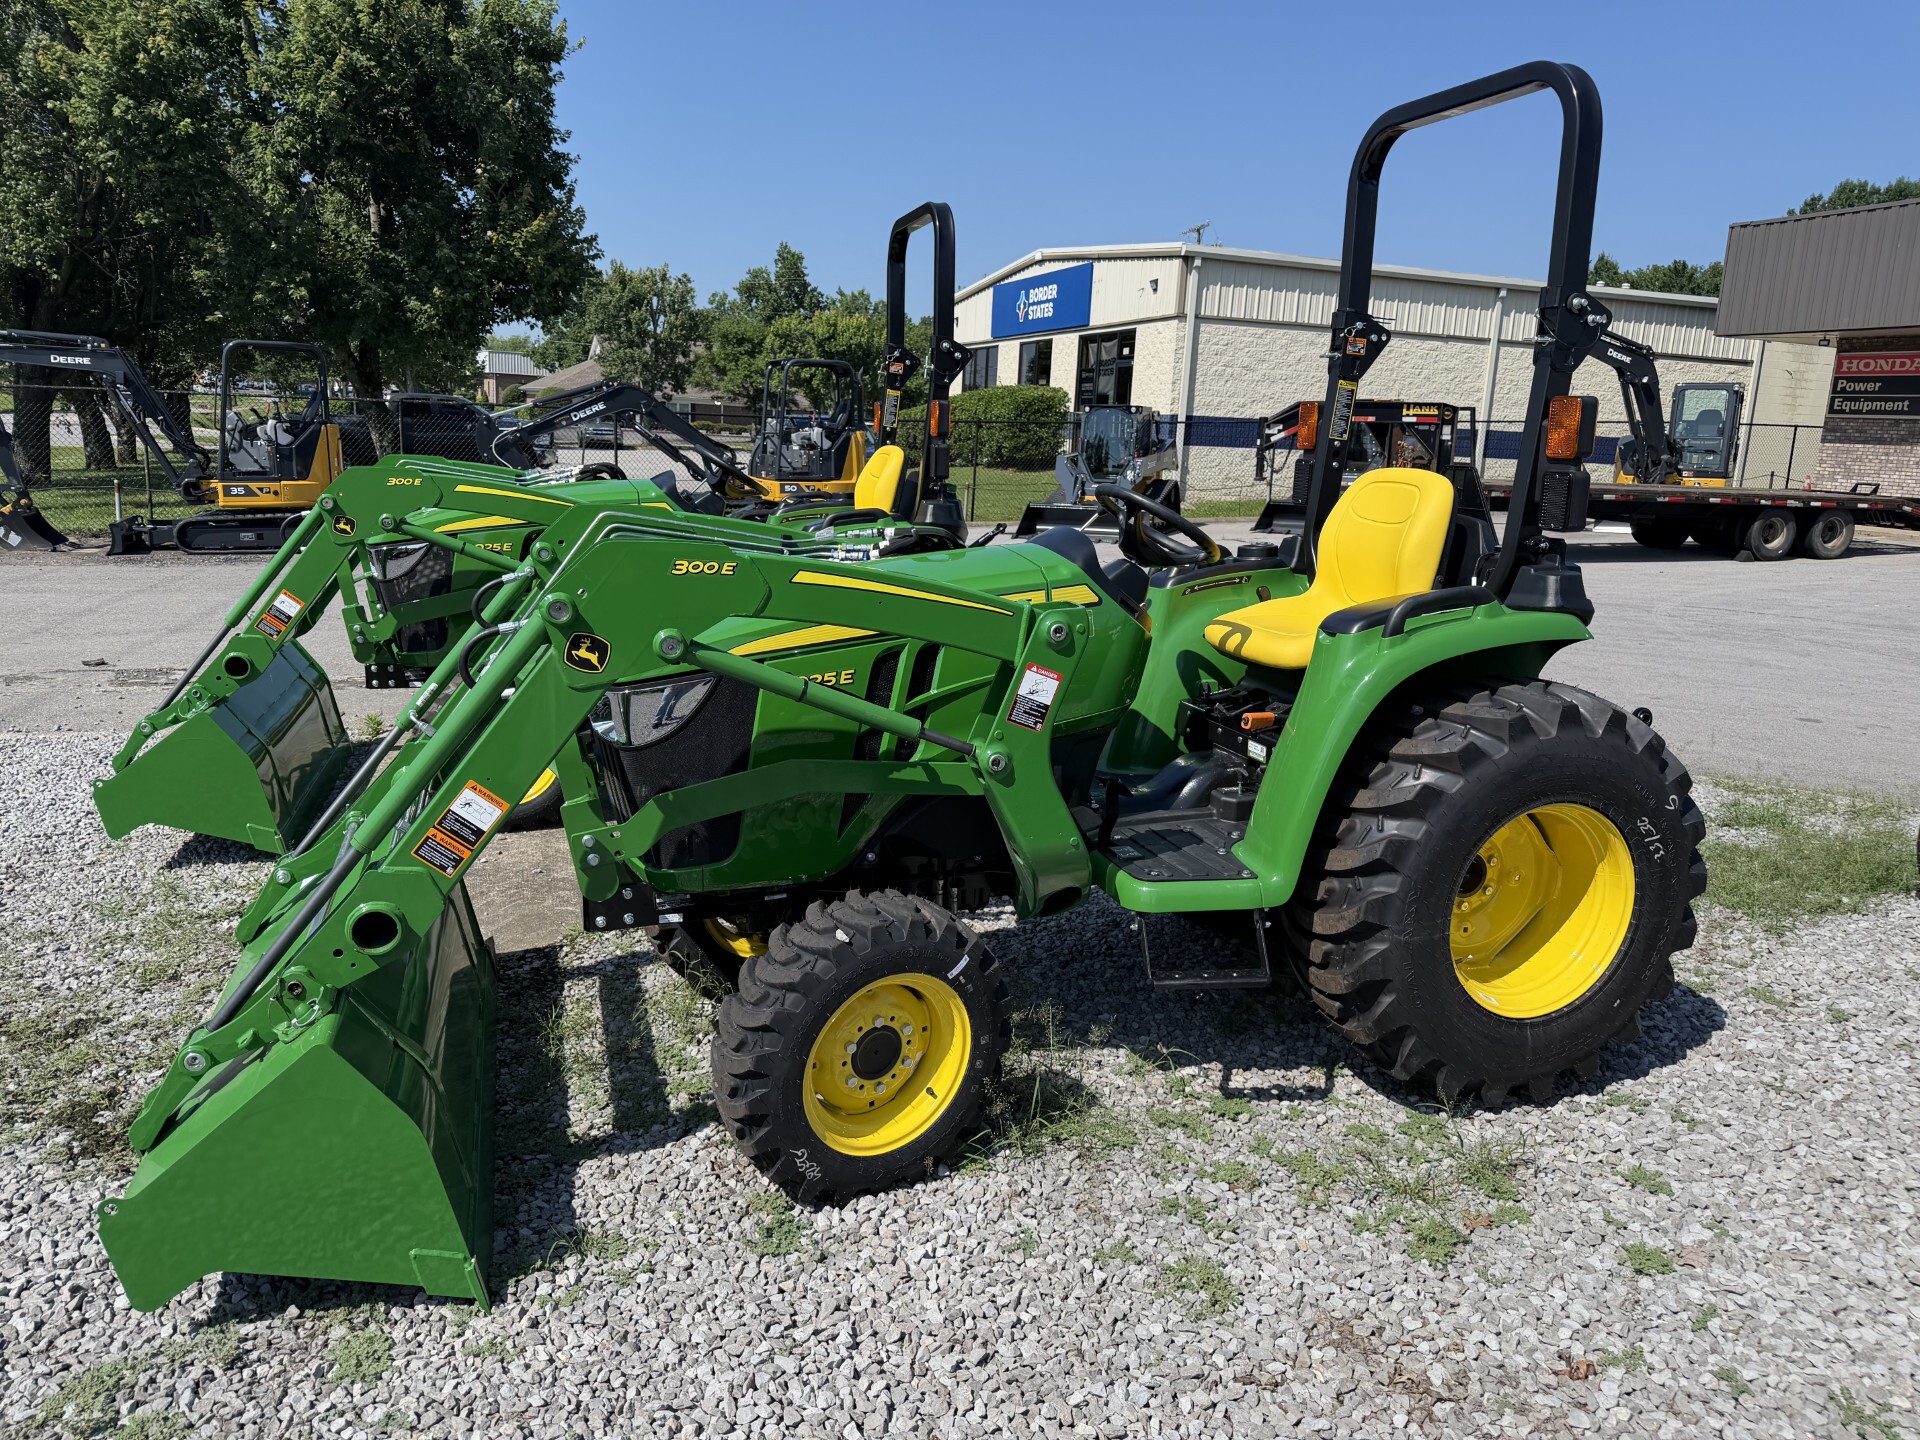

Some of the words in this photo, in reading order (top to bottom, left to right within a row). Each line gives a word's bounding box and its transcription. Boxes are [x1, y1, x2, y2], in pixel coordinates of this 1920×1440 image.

[1029, 284, 1058, 303] BORDER
[1028, 302, 1054, 320] STATES
[50, 354, 91, 365] DEERE
[1607, 348, 1632, 364] DEERE
[1837, 379, 1882, 392] Power
[570, 401, 607, 422] DEERE
[1402, 404, 1439, 416] HANK
[1834, 398, 1910, 413] Equipment
[230, 487, 245, 495] 35
[1037, 668, 1058, 680] DANGER
[477, 788, 504, 807] WARNING
[439, 836, 466, 856] WARNING
